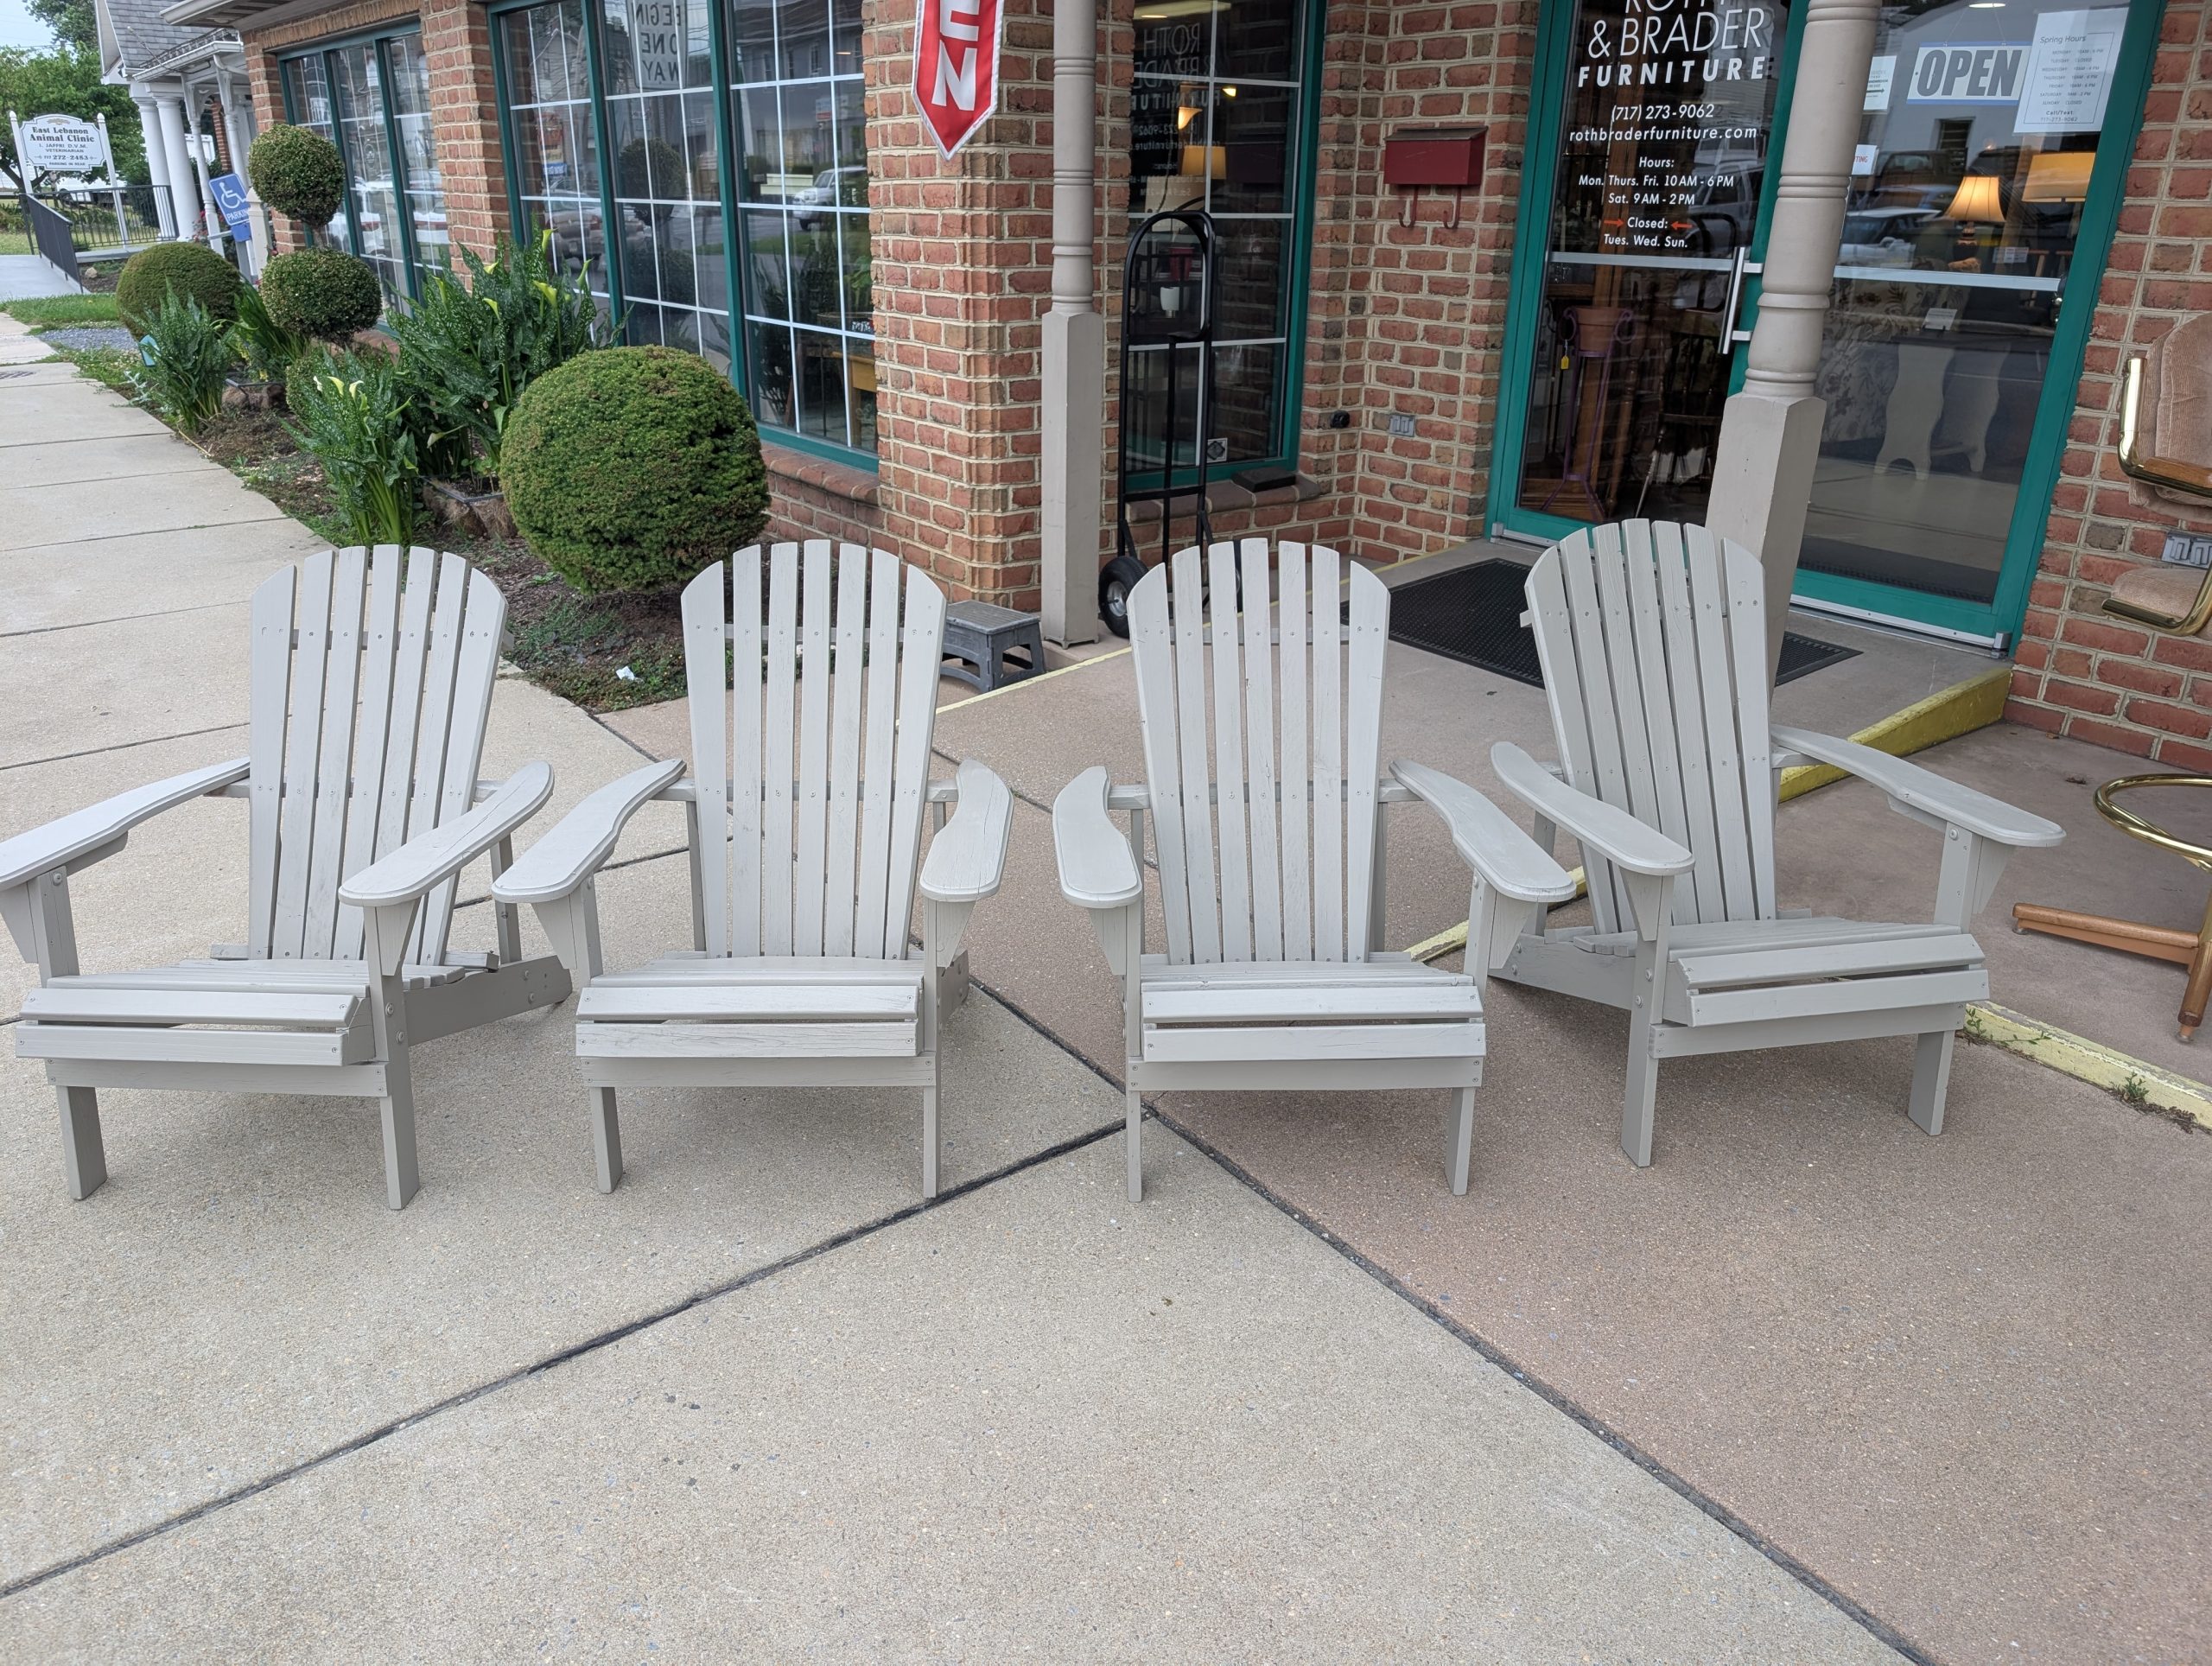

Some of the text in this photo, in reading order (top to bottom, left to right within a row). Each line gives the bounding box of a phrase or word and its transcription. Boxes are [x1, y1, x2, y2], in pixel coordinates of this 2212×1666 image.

[1587, 8, 1764, 59] & BRADER
[2039, 35, 2063, 45] Spring
[1578, 56, 1765, 87] FURNITURE
[1916, 49, 2023, 97] OPEN
[1611, 104, 1714, 122] (717) 273-9062
[29, 133, 95, 143] Animal Clinic
[1569, 126, 1758, 143] rothbraderfurniture.com
[1638, 156, 1675, 169] Hours:
[1579, 175, 1605, 186] Mon.
[1609, 175, 1638, 187] Thurs.
[1643, 175, 1659, 187] Fri.
[1608, 193, 1629, 204] Sat.
[226, 209, 249, 221] PARKIN
[1627, 216, 1669, 229] Closed:
[1604, 233, 1688, 248] Tues. Wed. Sun.
